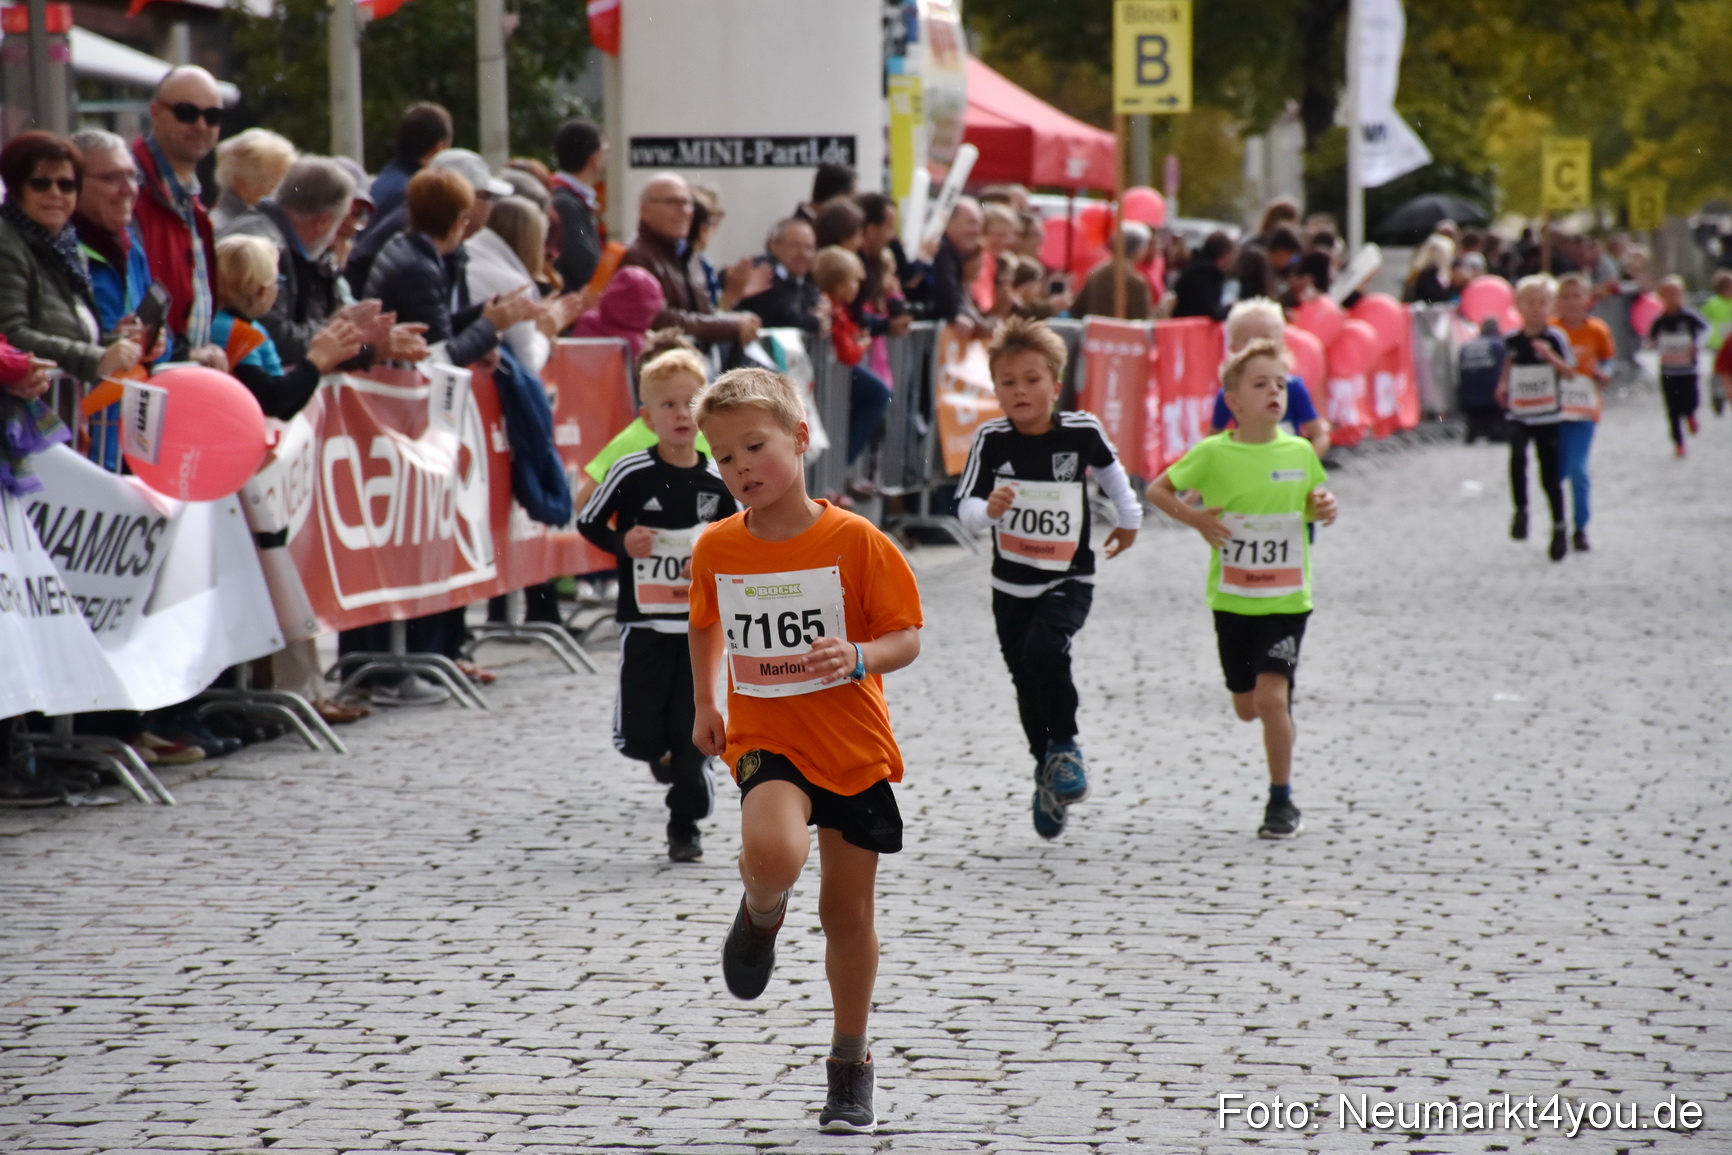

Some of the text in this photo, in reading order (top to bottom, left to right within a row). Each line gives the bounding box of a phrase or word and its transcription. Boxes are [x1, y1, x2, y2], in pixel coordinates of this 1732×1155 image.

[1136, 35, 1169, 85] B
[1553, 160, 1577, 192] C
[1009, 507, 1070, 536] 7063
[1232, 539, 1289, 564] 7131
[757, 583, 801, 597] BOCK
[734, 608, 826, 649] 7165
[760, 662, 806, 676] Marlon
